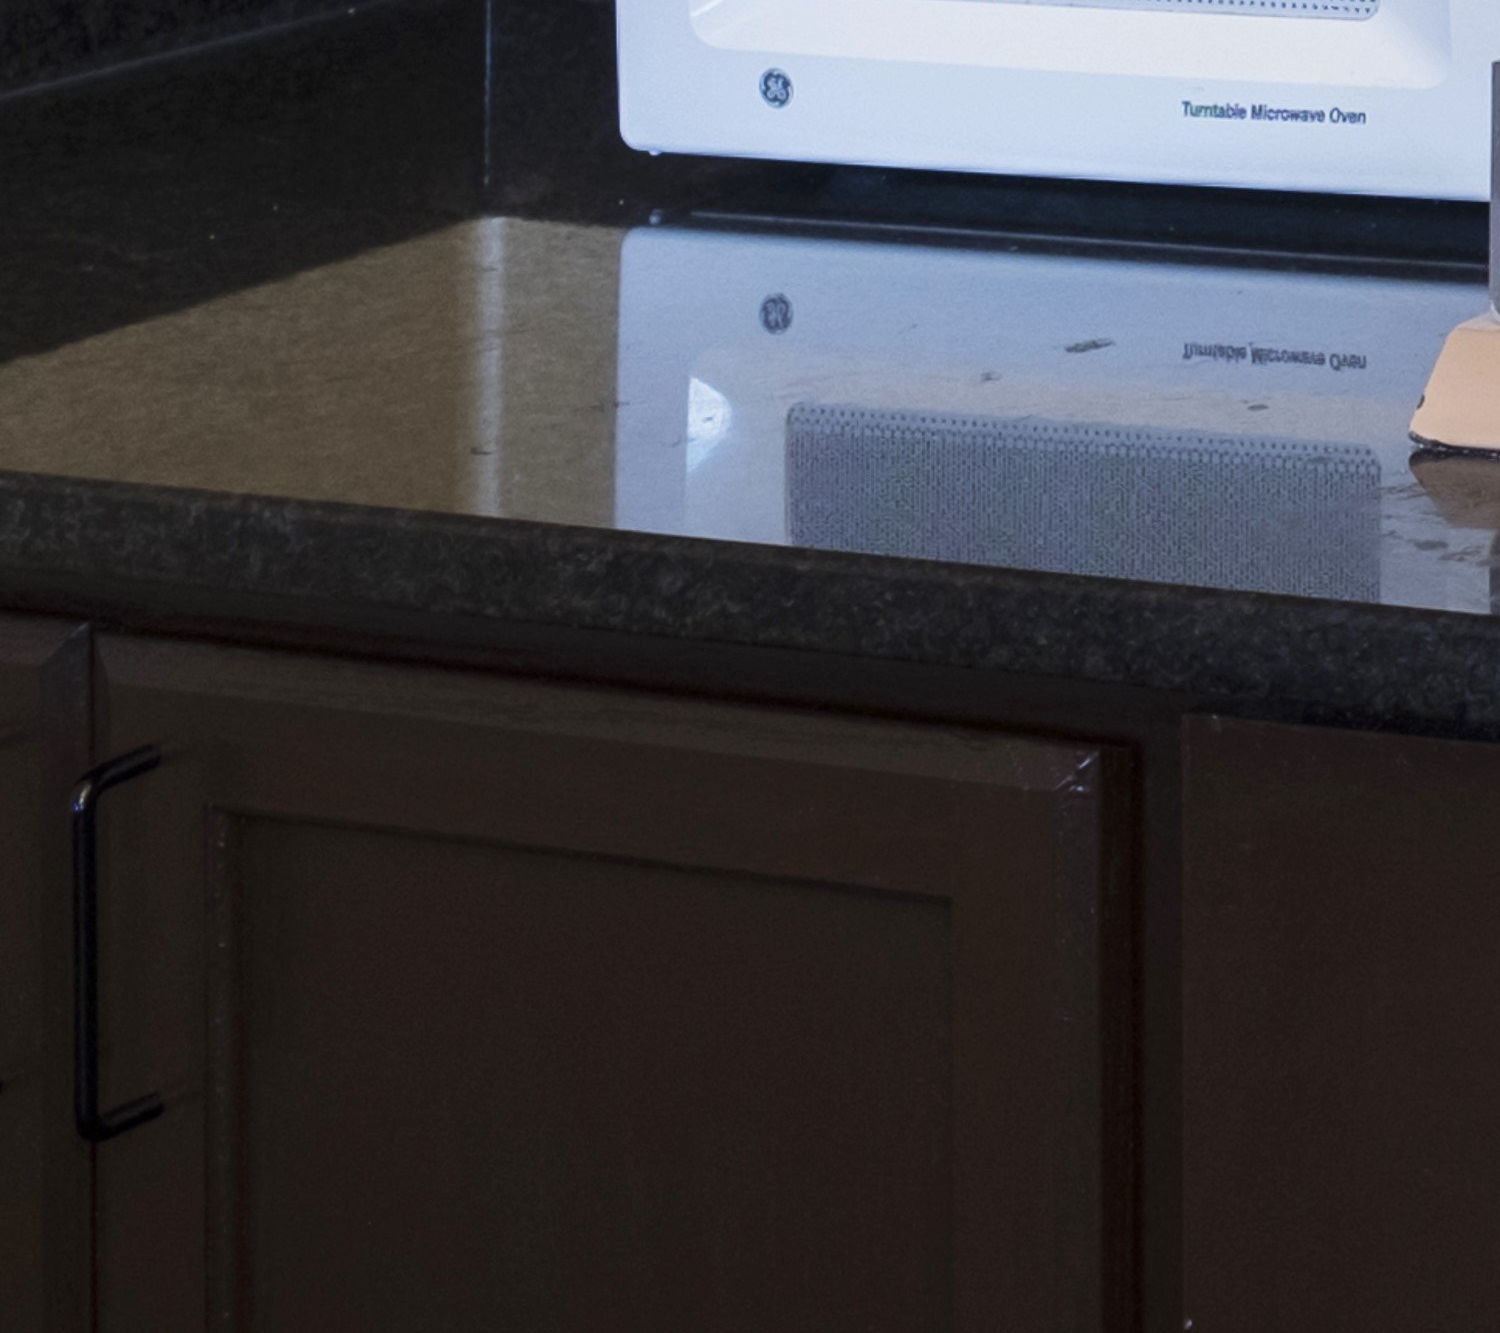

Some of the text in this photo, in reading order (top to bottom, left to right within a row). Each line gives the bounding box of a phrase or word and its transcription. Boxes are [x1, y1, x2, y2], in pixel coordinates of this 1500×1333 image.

[1181, 100, 1367, 125] Turntable Microwave Oven
